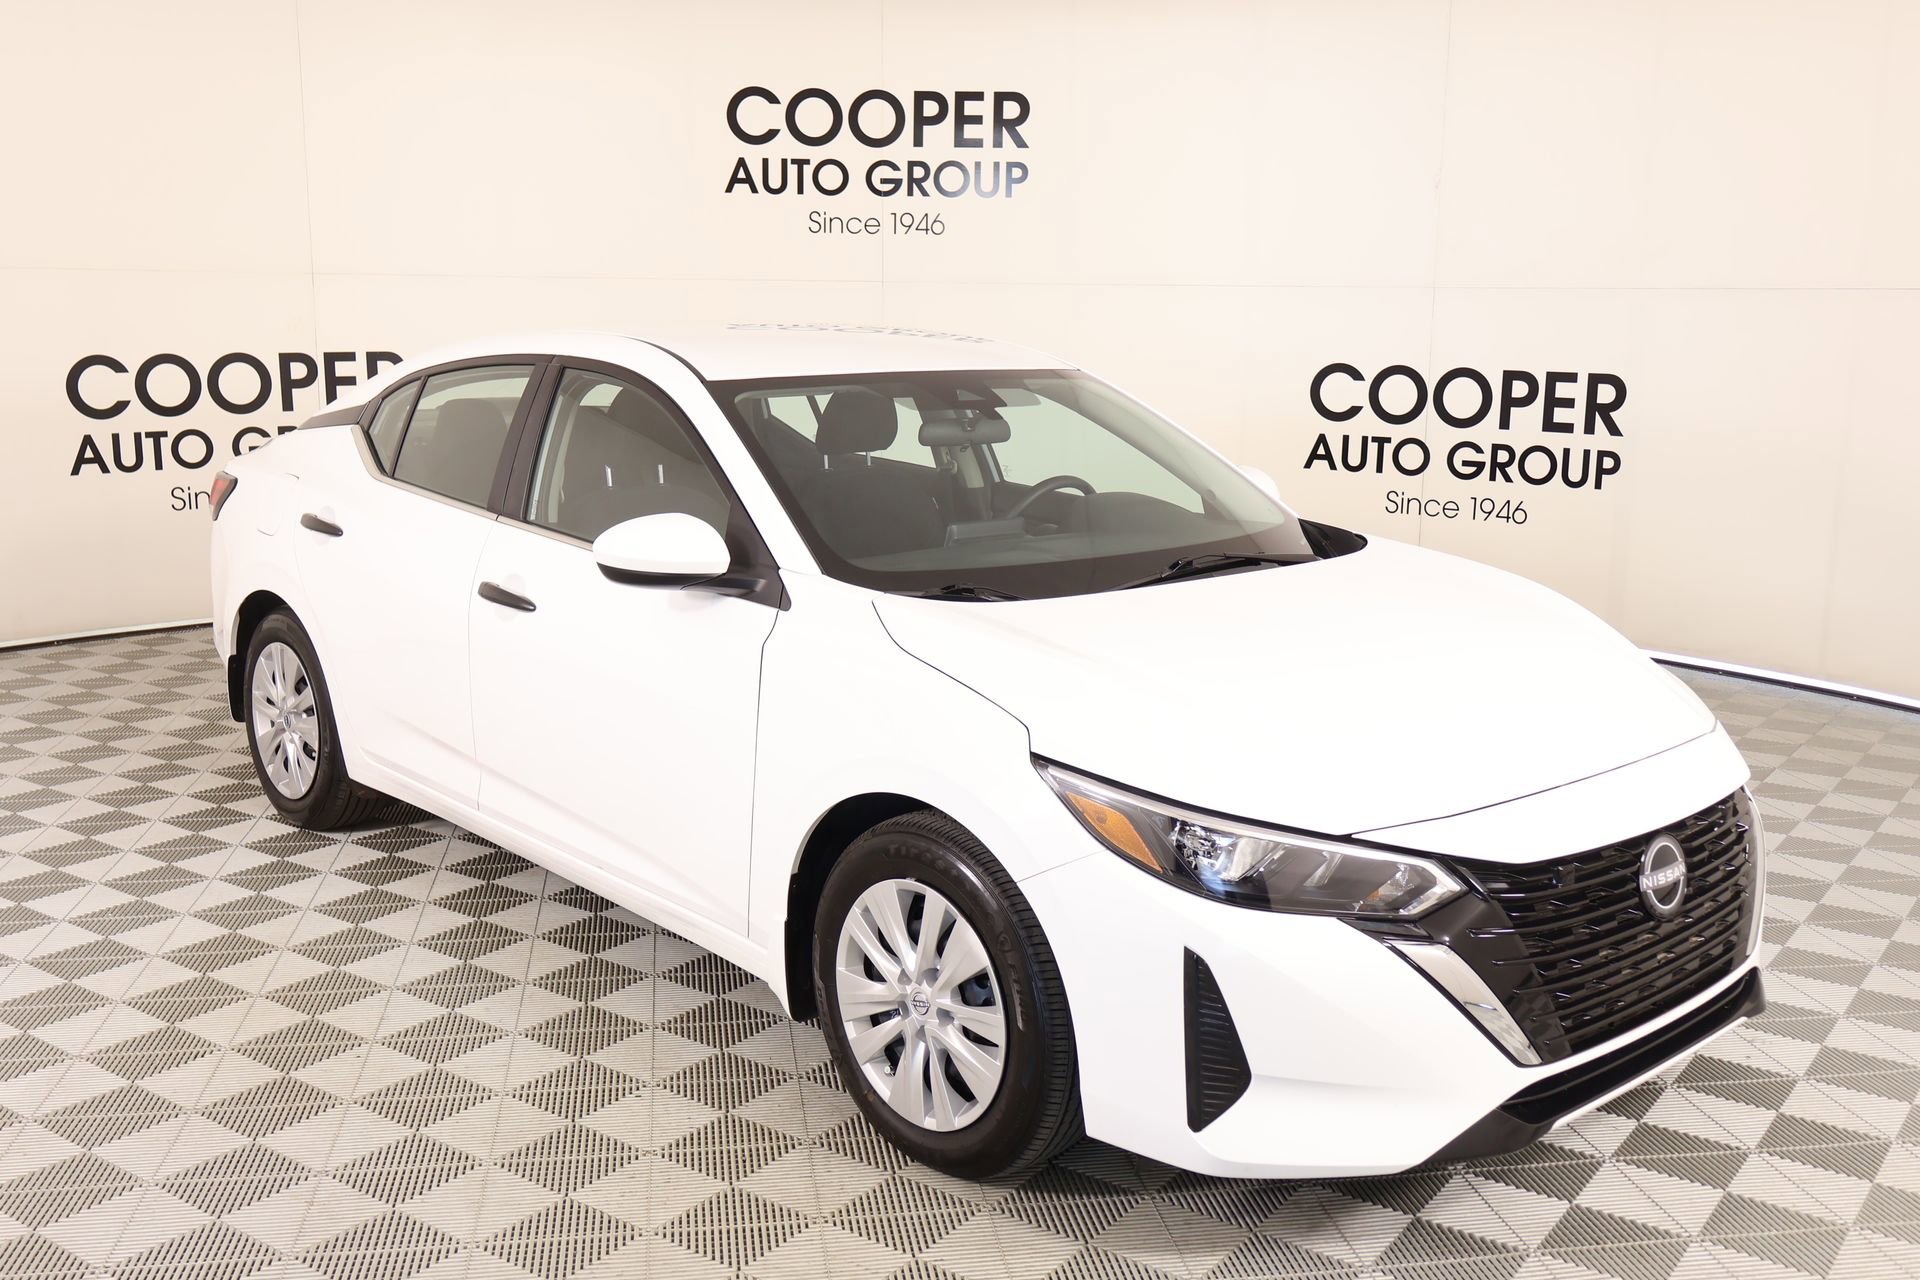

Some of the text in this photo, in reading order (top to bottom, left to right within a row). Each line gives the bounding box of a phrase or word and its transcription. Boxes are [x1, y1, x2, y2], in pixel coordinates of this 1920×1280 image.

[726, 86, 1031, 148] COOPER
[725, 157, 1029, 198] AUTO GROUP
[808, 211, 946, 235] Since 1946
[1310, 363, 1627, 437] COOPER
[70, 429, 214, 476] AUTO
[1303, 433, 1622, 490] AUTO GROUP
[171, 486, 211, 511] Sin
[1385, 491, 1528, 524] Since 1946
[1642, 862, 1686, 889] NISSAN
